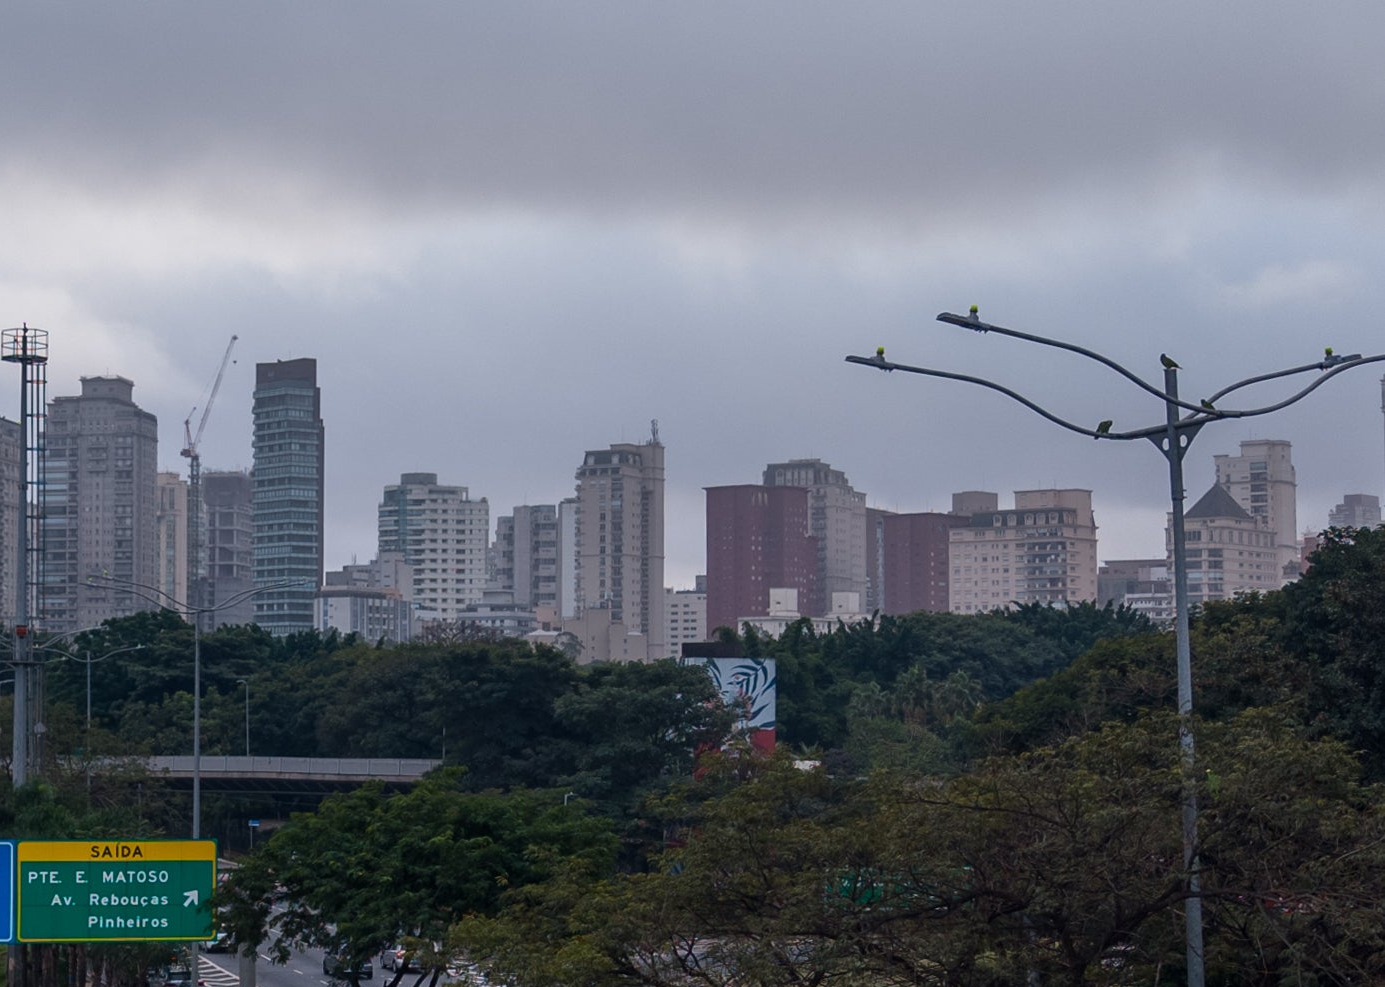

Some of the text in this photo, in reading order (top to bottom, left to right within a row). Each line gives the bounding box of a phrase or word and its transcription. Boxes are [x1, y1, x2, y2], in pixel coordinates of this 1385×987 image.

[90, 842, 143, 858] SAÍDA
[28, 870, 169, 884] PTE. E. MATOSO
[51, 893, 169, 907] Av. Rebouças
[88, 916, 169, 928] Pinheiros
